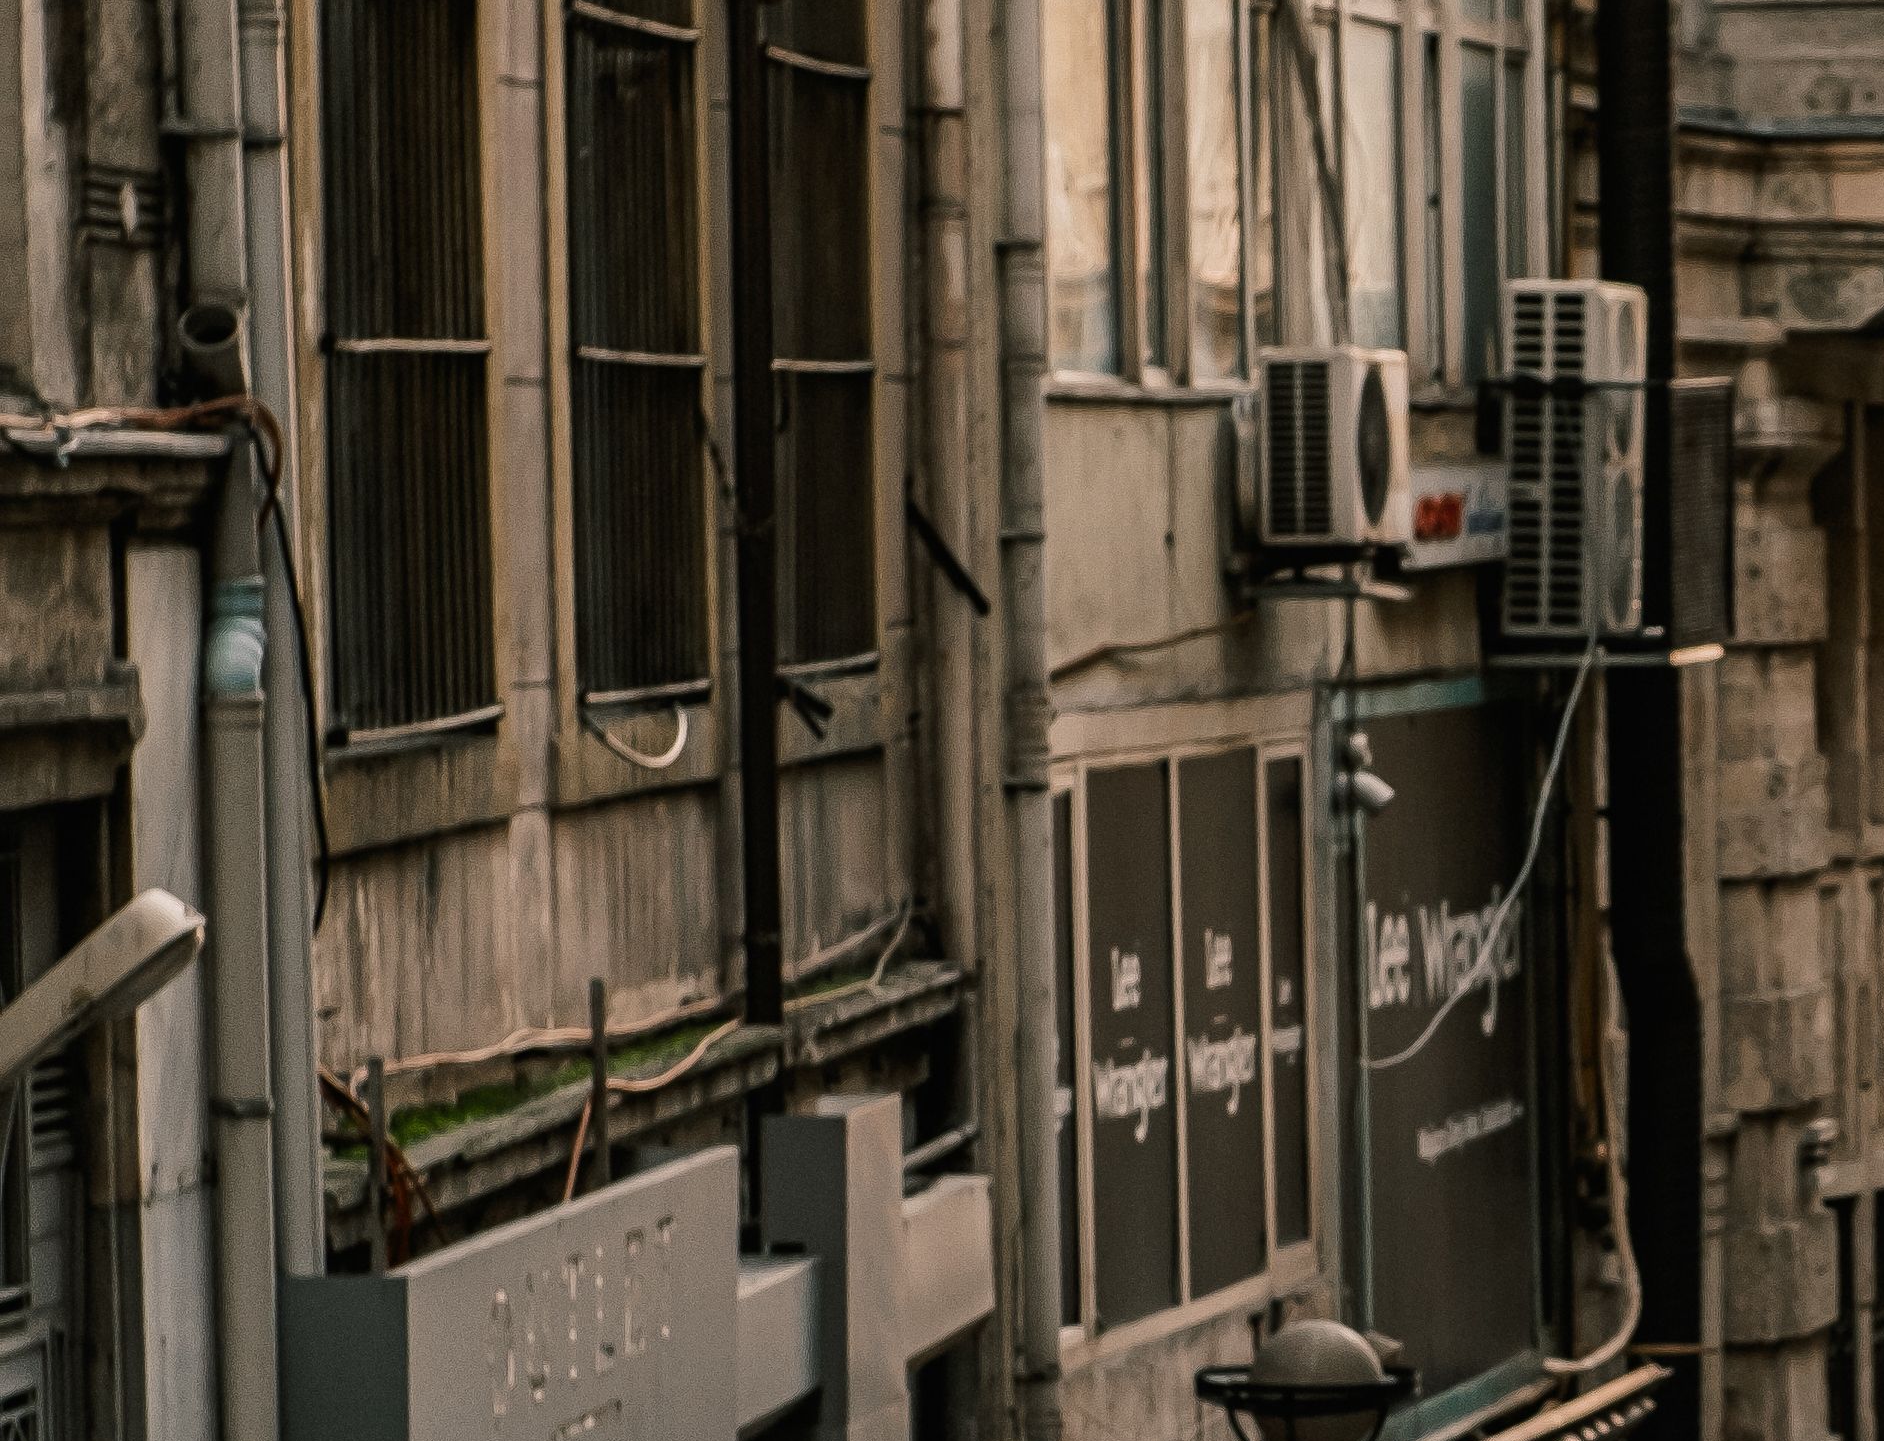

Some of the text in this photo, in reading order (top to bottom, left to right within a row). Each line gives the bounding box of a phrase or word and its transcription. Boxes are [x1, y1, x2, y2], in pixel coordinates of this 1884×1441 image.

[1111, 945, 1141, 1012] Lee
[1204, 928, 1232, 990] Lee
[1366, 900, 1410, 1009] Lee
